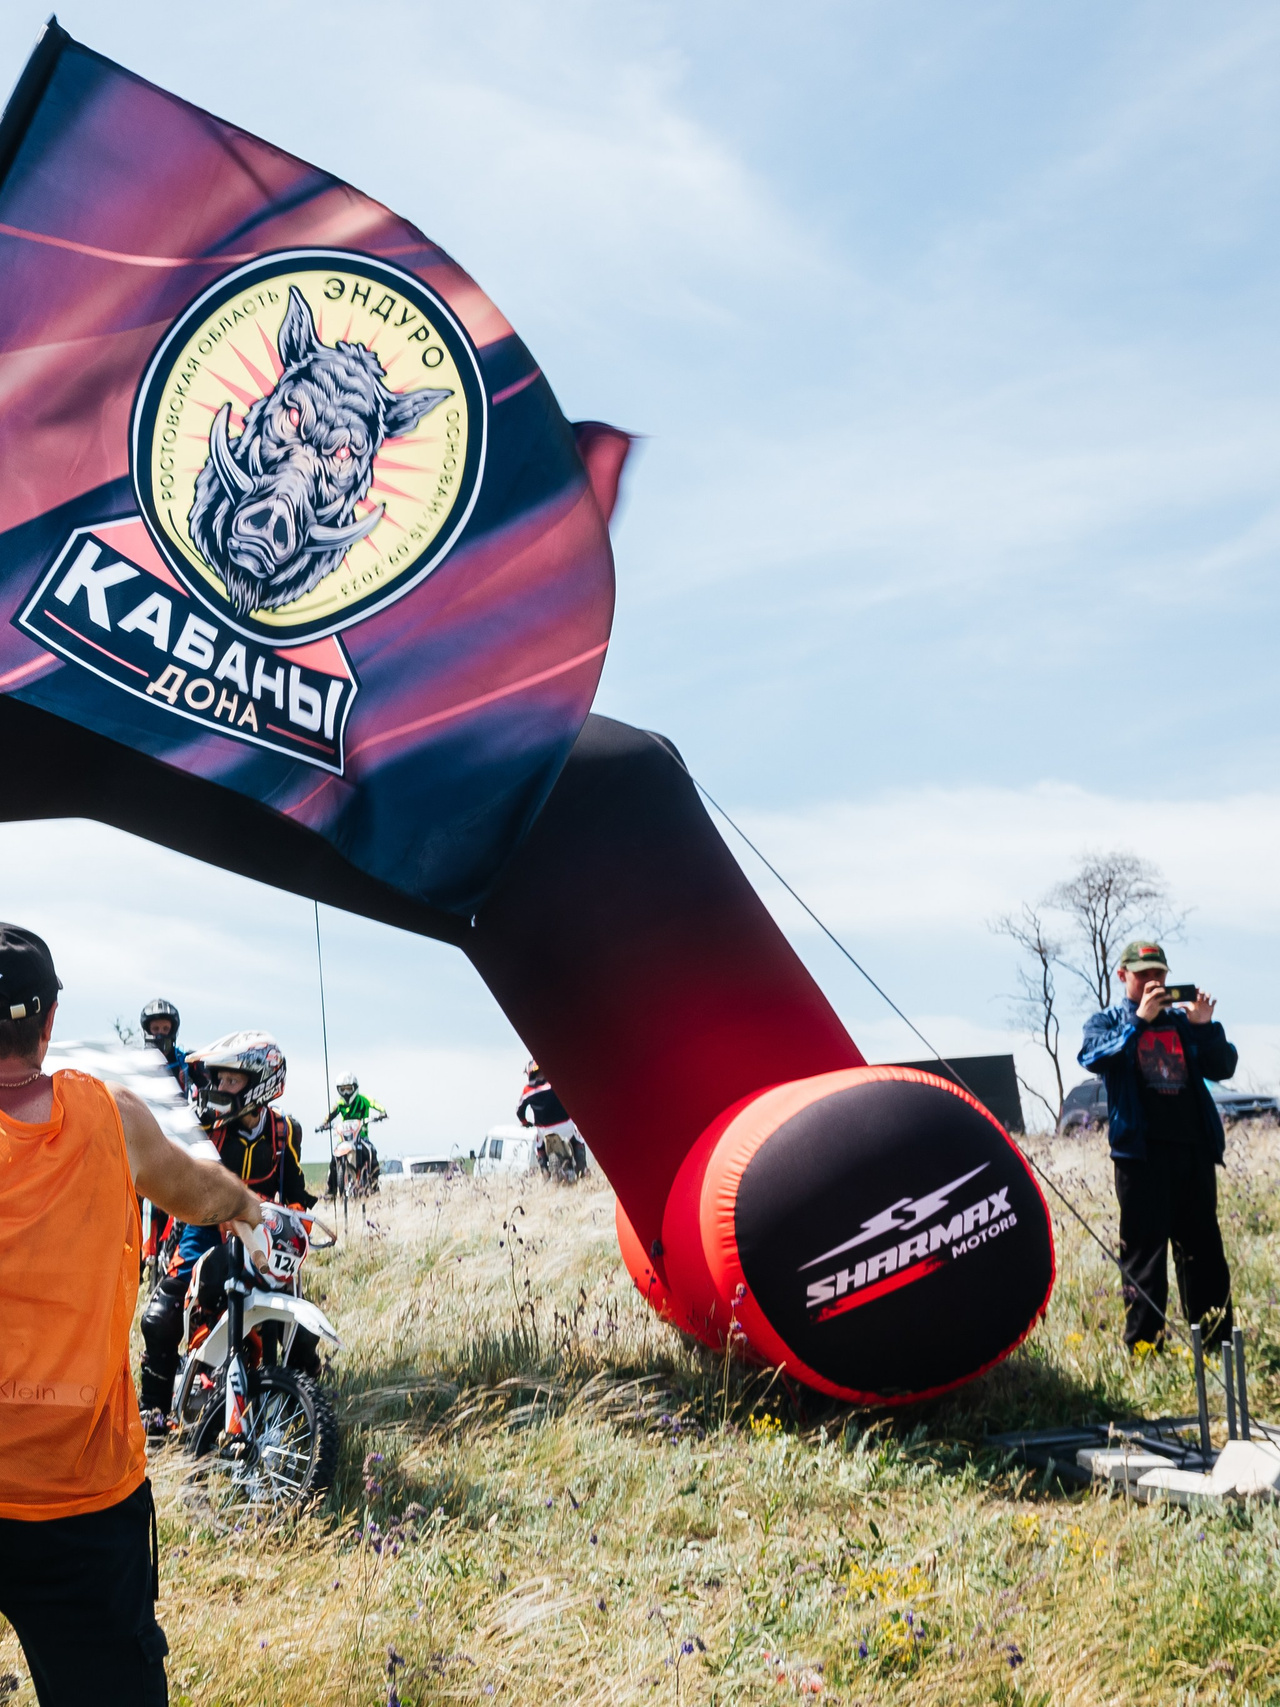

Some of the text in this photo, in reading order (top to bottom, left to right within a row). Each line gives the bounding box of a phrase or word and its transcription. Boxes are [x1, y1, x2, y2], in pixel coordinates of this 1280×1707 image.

[322, 277, 445, 369] ЭНДУРО
[159, 289, 280, 501] РОСТОВСКАЯ ОБЛАСТЬ
[53, 539, 345, 741] КАБАНЫ
[145, 663, 259, 733] ДОНА
[806, 1186, 1012, 1308] SHARMAX
[951, 1212, 1018, 1259] MOTORS
